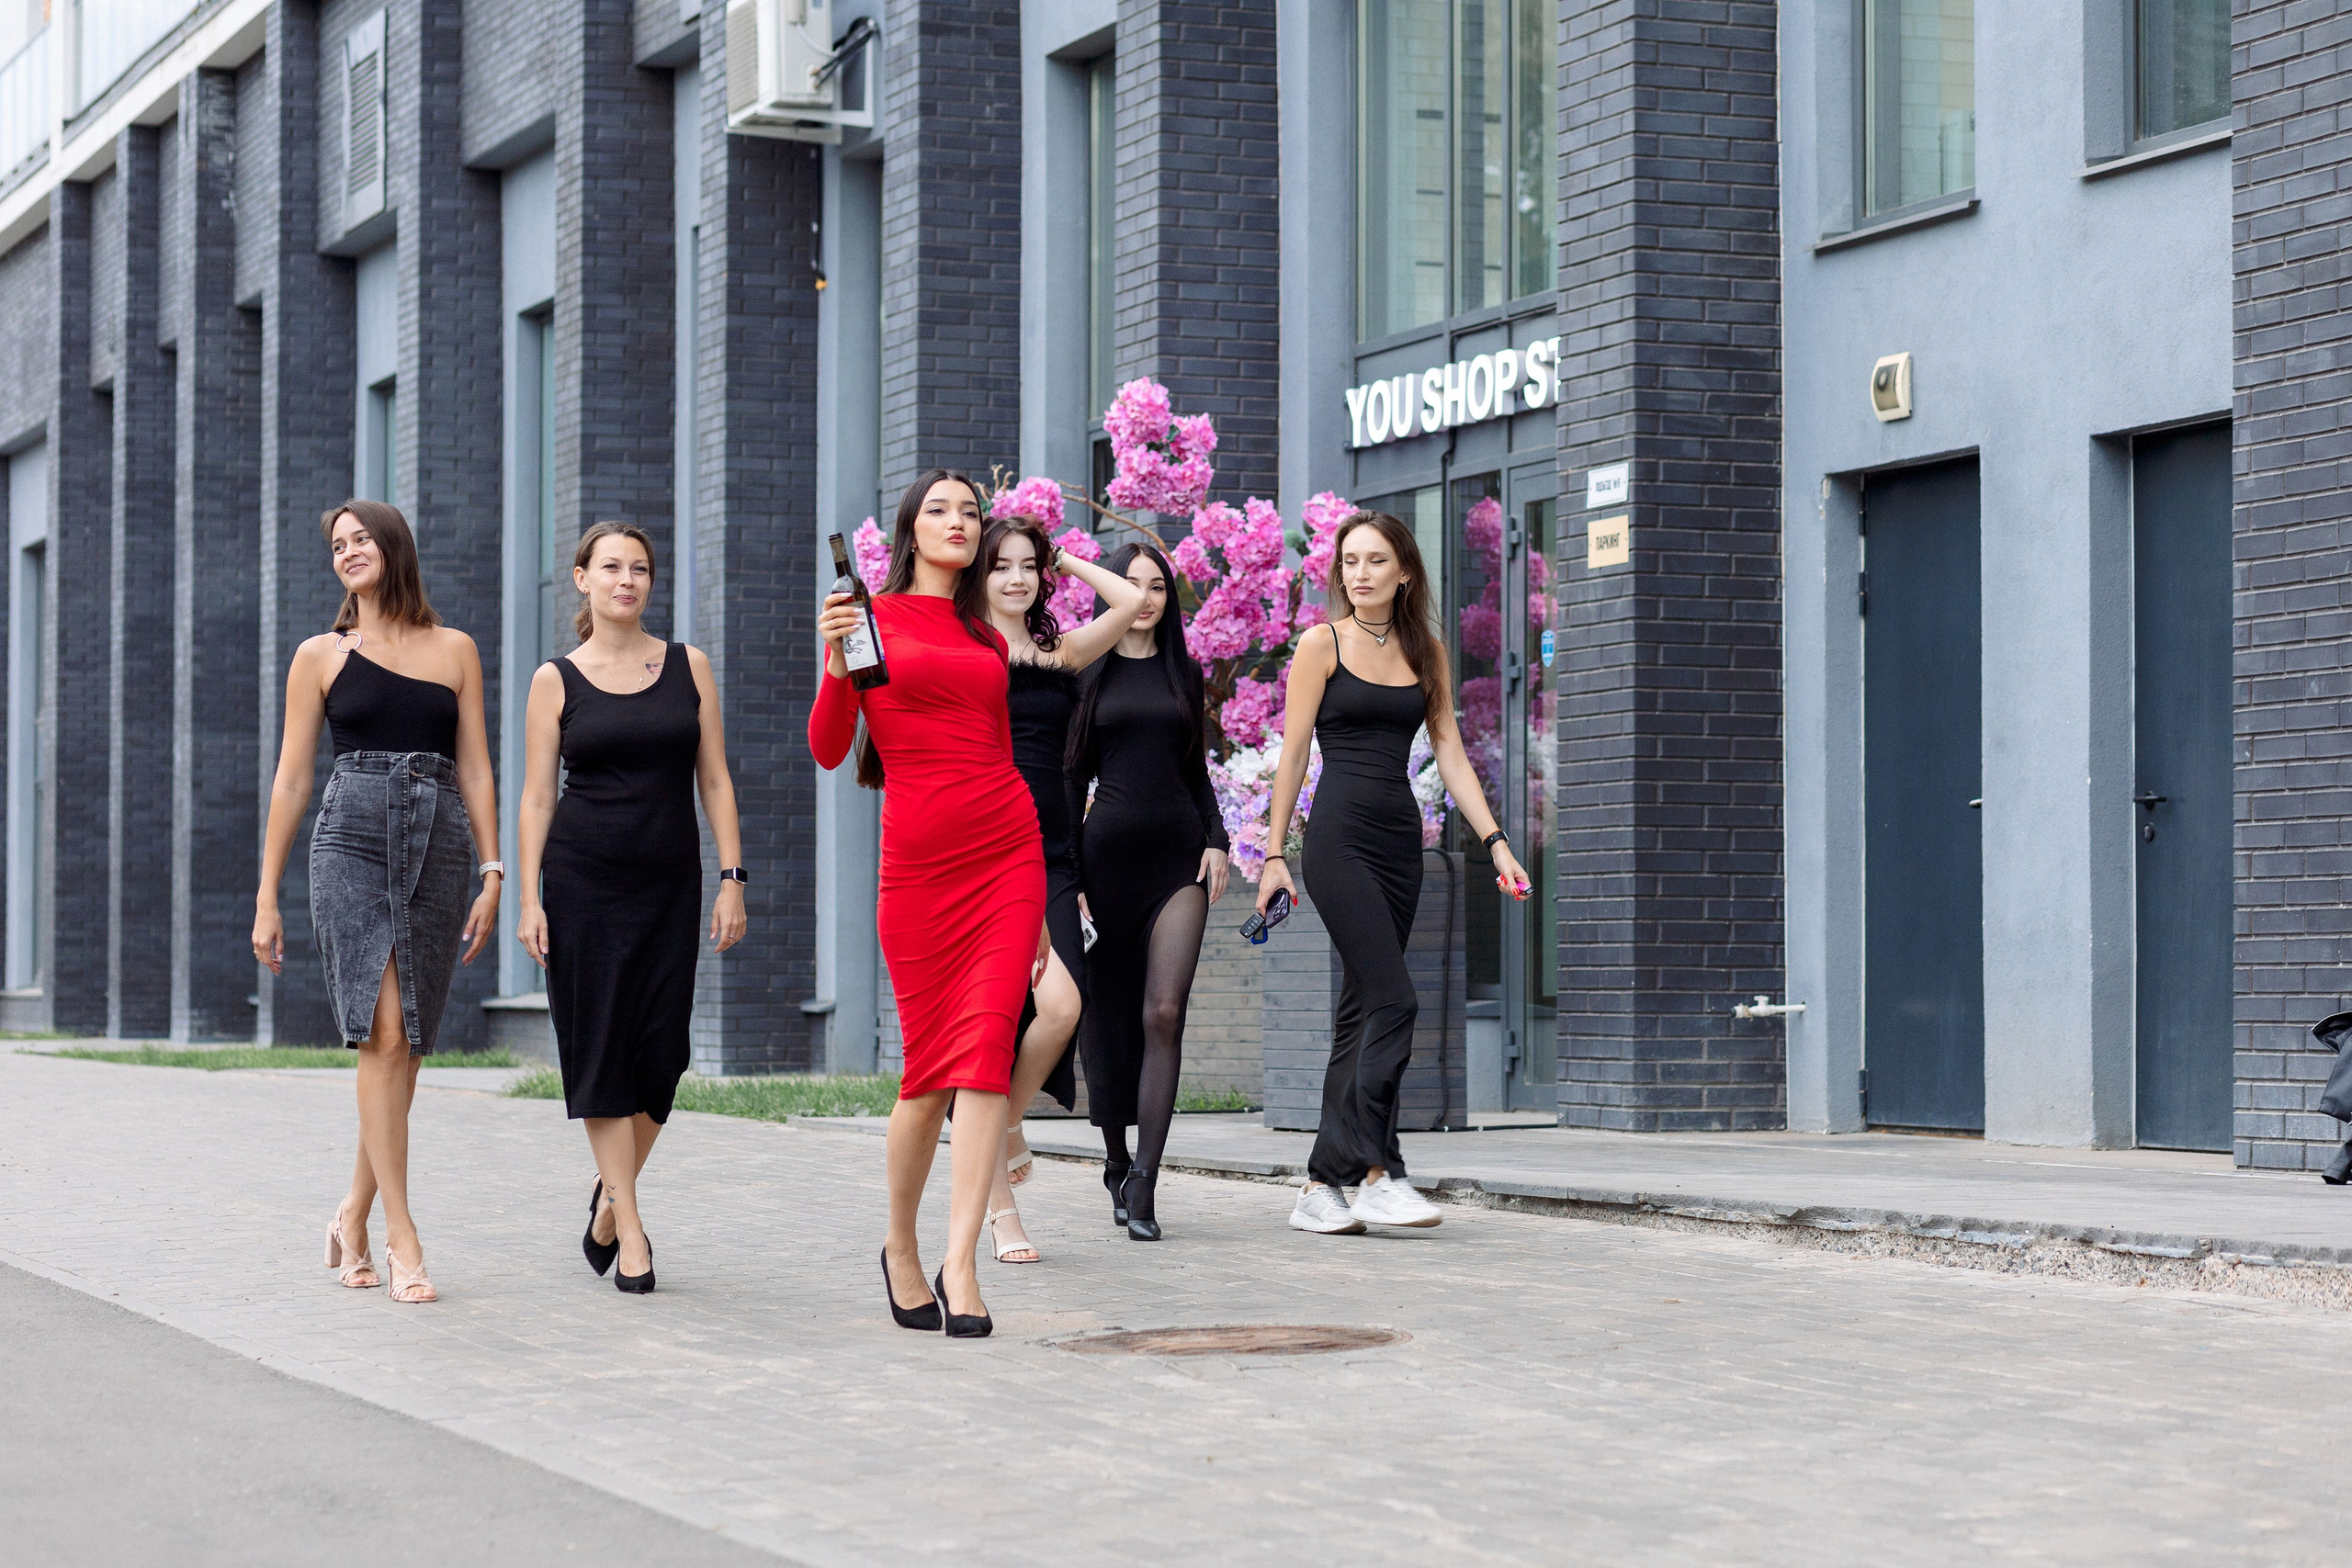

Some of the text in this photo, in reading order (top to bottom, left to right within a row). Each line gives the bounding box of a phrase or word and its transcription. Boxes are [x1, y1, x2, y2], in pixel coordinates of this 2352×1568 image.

[1345, 373, 1414, 447] YOU
[1420, 349, 1518, 433] SHOP
[1596, 533, 1620, 551] ПАРКИНГ
